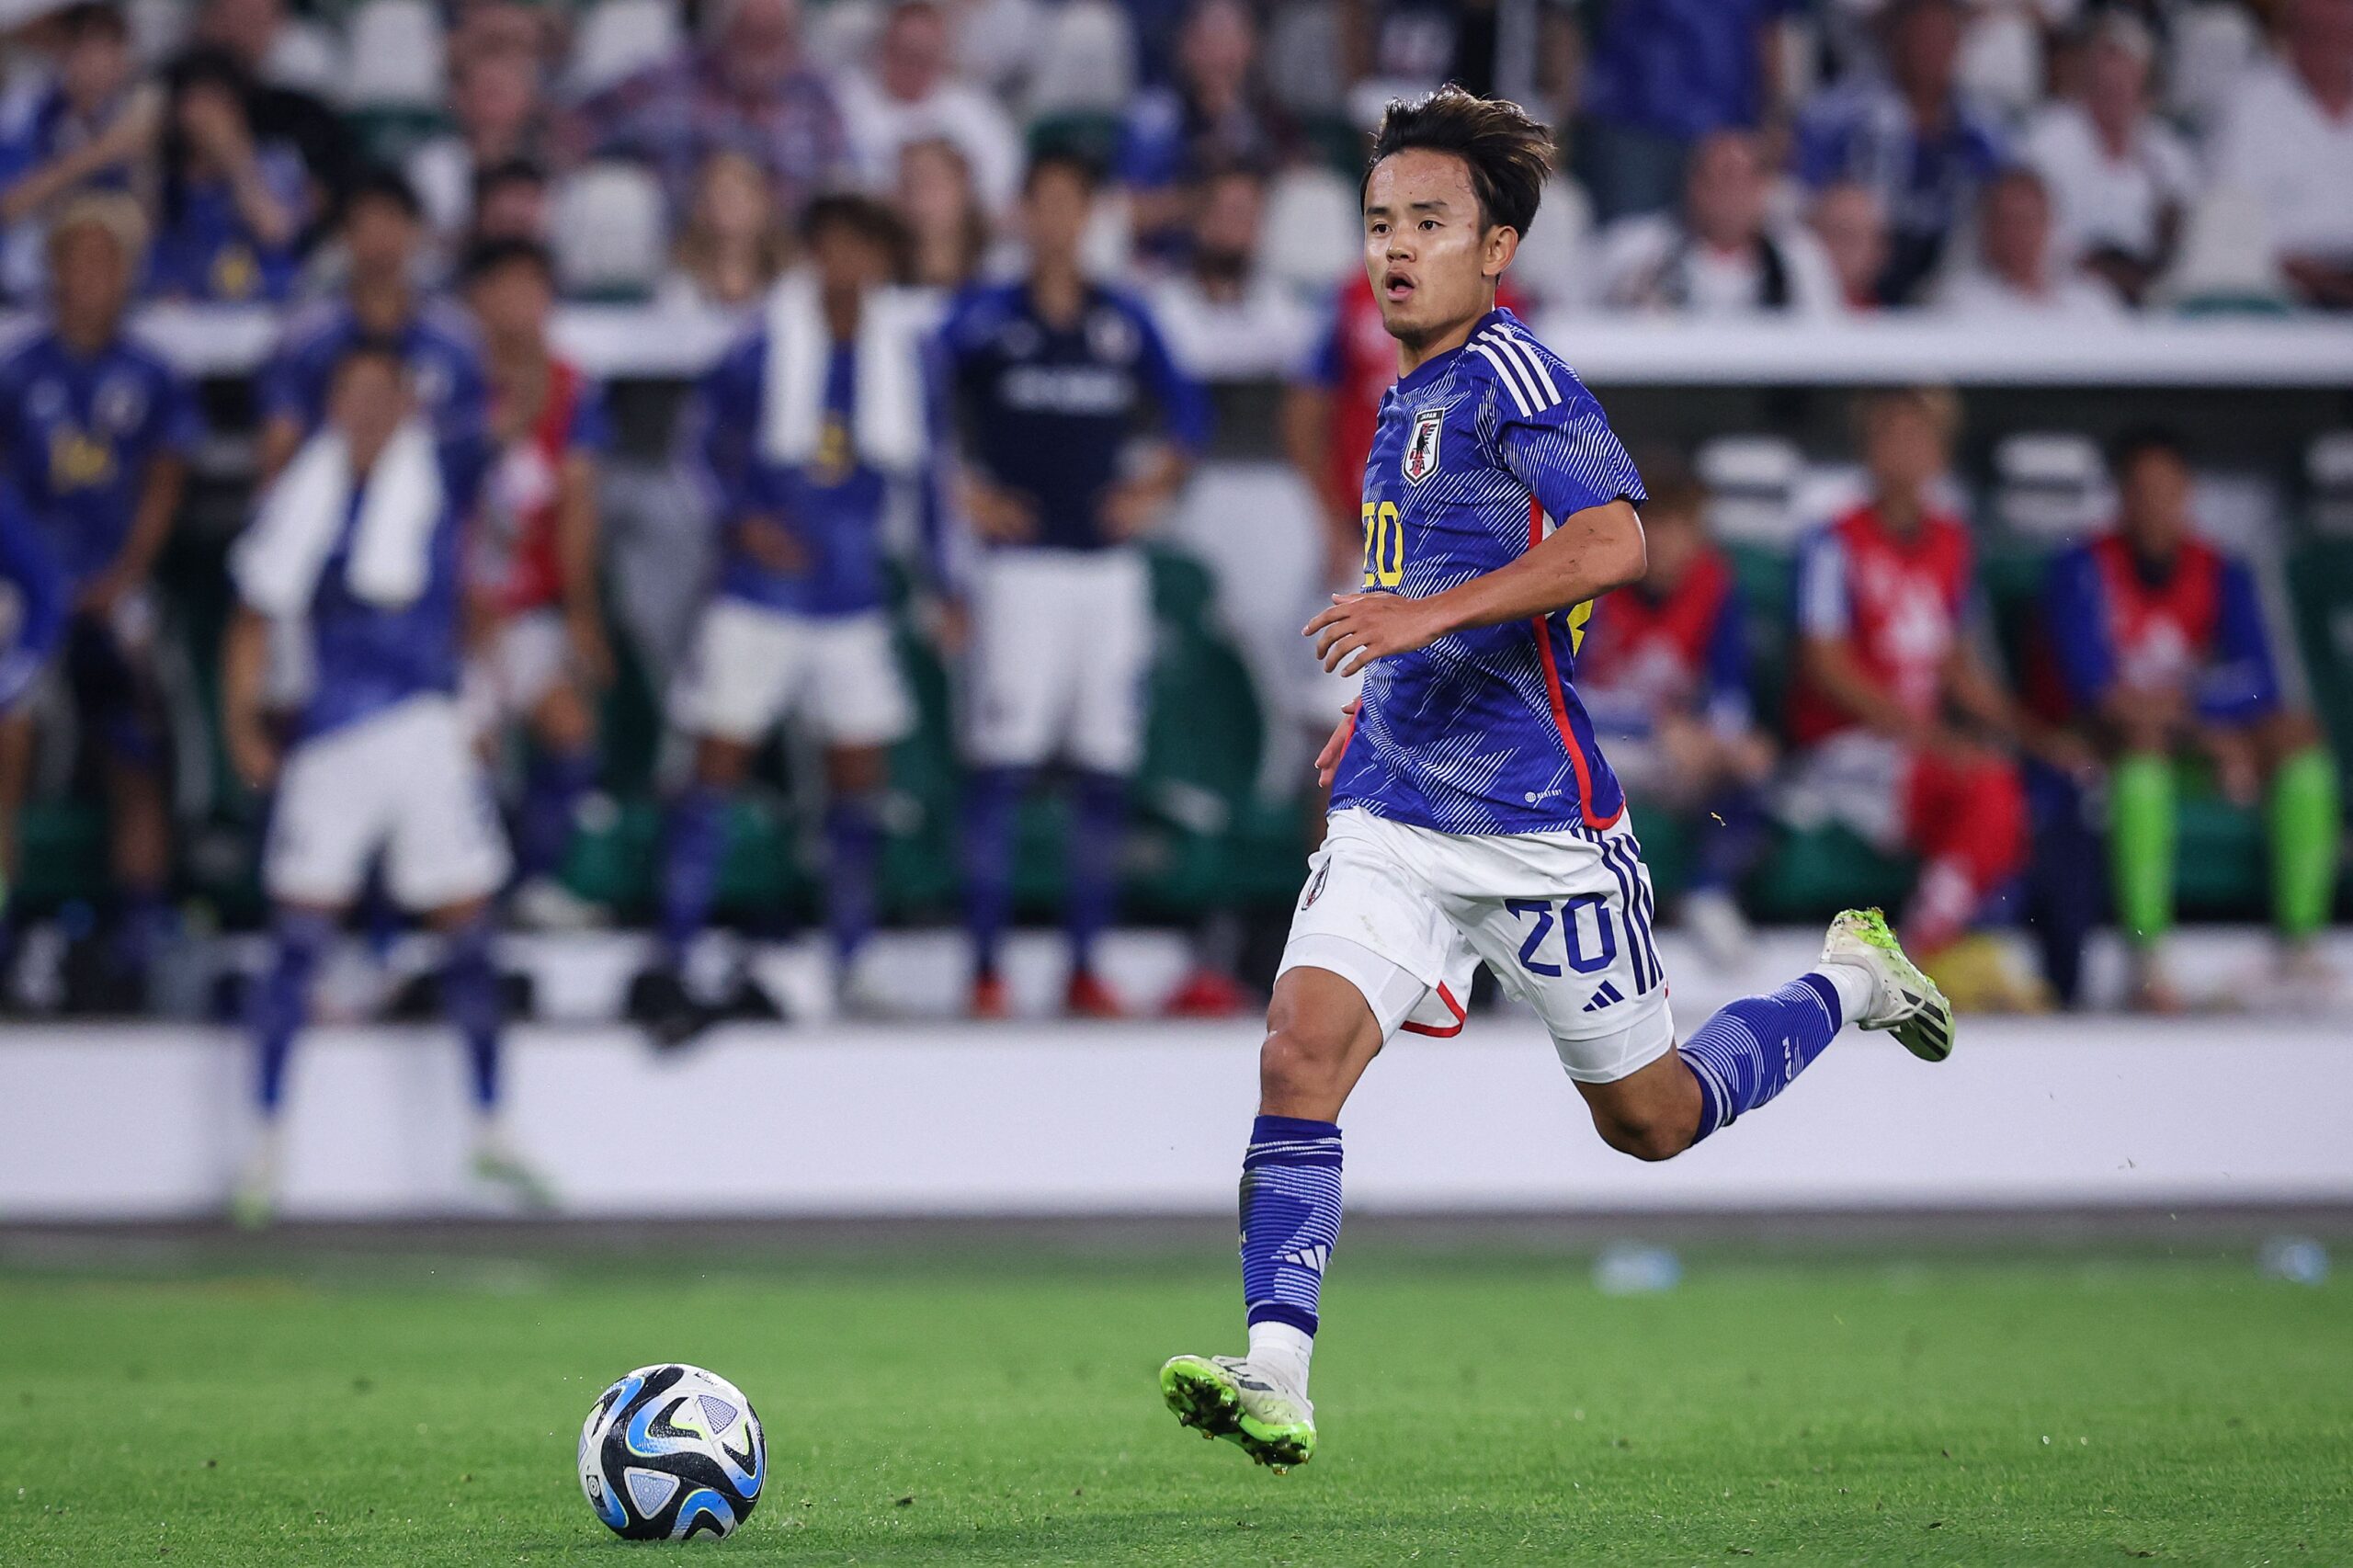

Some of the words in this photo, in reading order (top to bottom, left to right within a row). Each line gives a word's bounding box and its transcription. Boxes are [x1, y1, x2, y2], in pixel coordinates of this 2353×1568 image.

[1420, 412, 1438, 421] JAPAN
[1409, 460, 1426, 472] JA
[1505, 892, 1617, 977] 20
